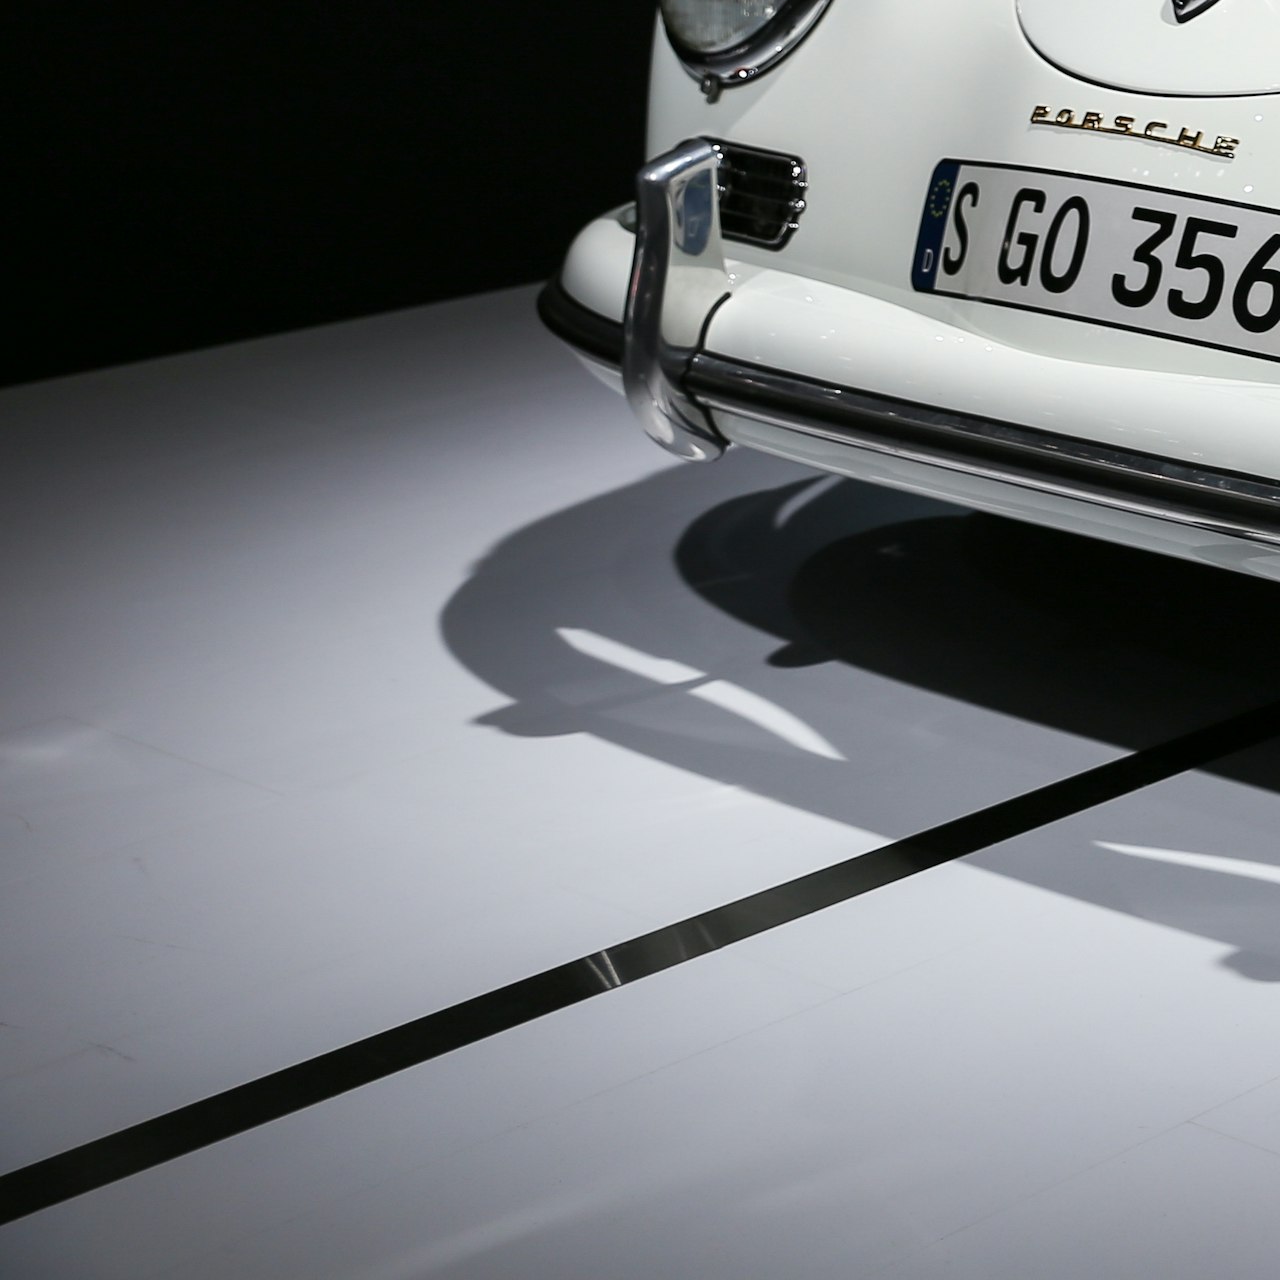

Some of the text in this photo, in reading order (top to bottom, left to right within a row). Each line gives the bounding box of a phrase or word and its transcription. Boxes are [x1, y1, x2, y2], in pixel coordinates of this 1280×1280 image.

[1031, 105, 1241, 159] PORSCHE
[921, 248, 934, 273] D
[942, 182, 980, 276] S
[998, 188, 1090, 294] GO
